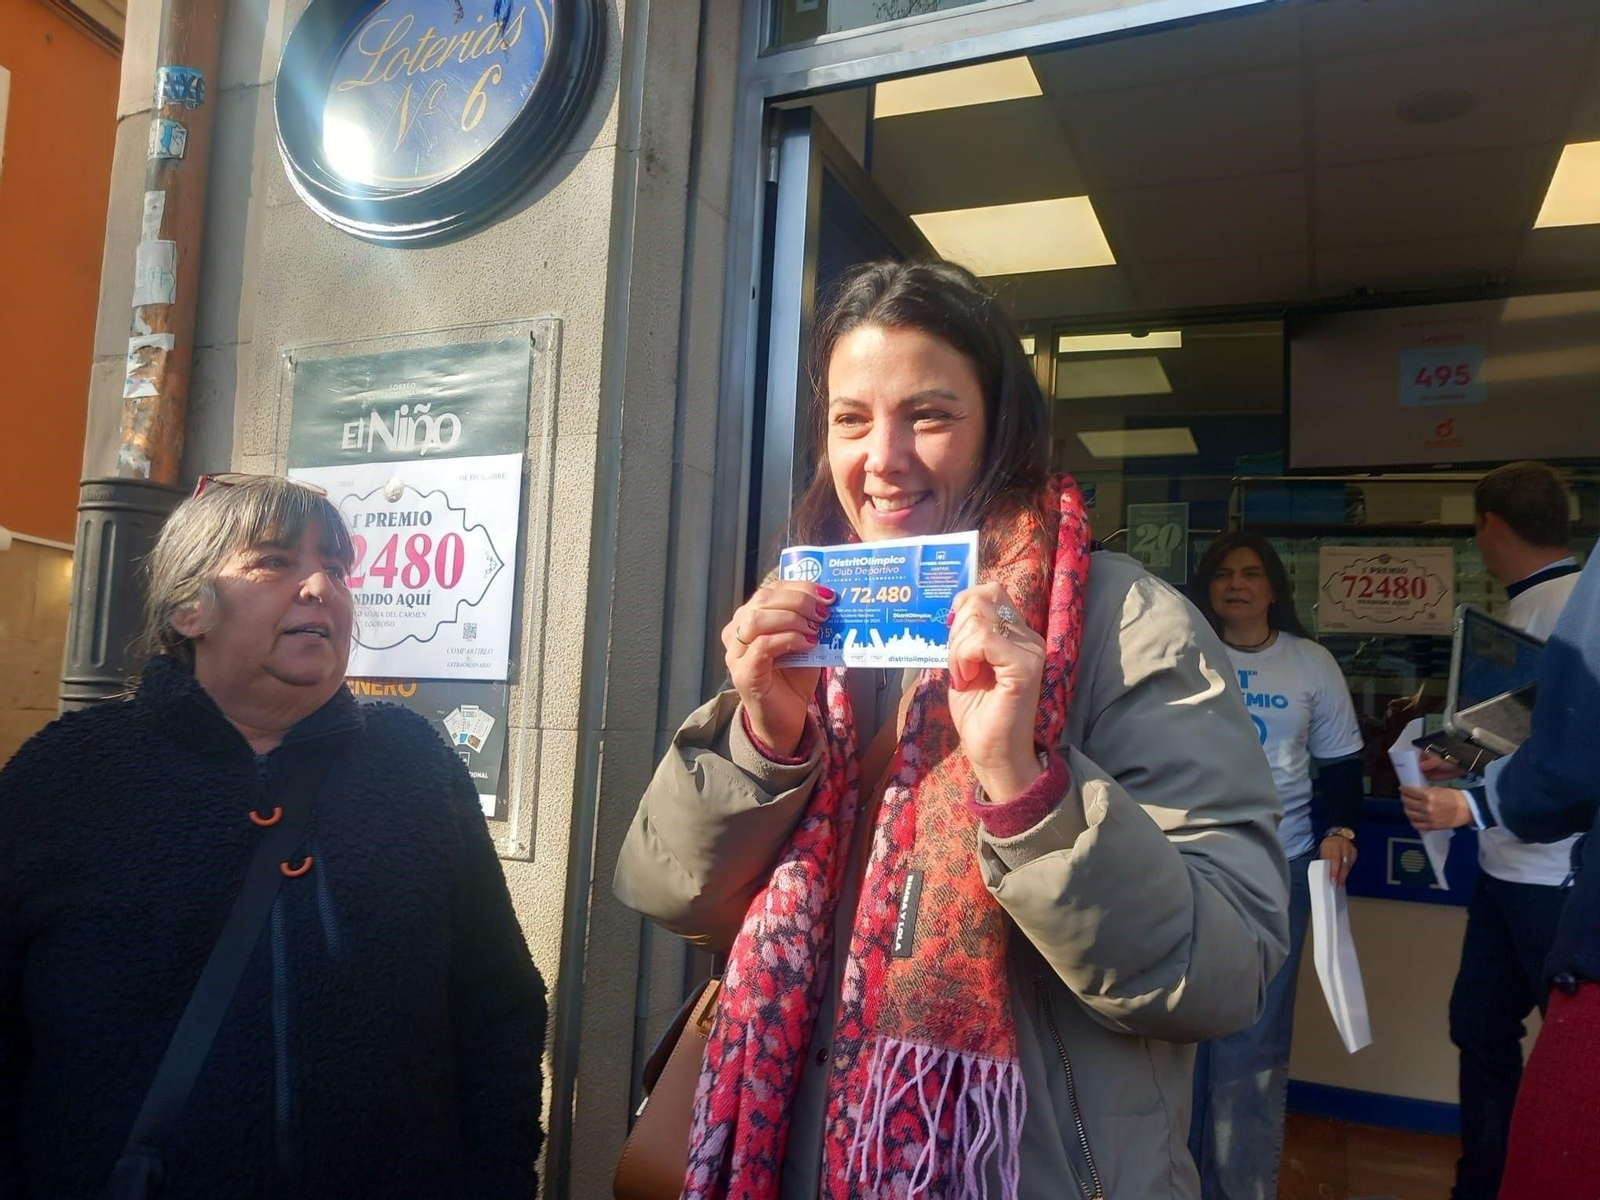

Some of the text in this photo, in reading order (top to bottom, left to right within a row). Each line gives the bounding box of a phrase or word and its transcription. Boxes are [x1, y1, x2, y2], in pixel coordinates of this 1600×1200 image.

[461, 64, 502, 132] 6
[1414, 363, 1472, 388] 495
[341, 402, 462, 457] El Niño
[364, 510, 433, 528] PREMIO
[1132, 522, 1183, 553] 20
[346, 532, 466, 590] 2480
[832, 566, 900, 577] Club Deportivo
[354, 590, 432, 609] NDIDO AQUÍ
[850, 585, 912, 604] 72.480
[1341, 574, 1427, 600] 72480
[900, 911, 907, 921] Y
[895, 922, 905, 951] LOLA
